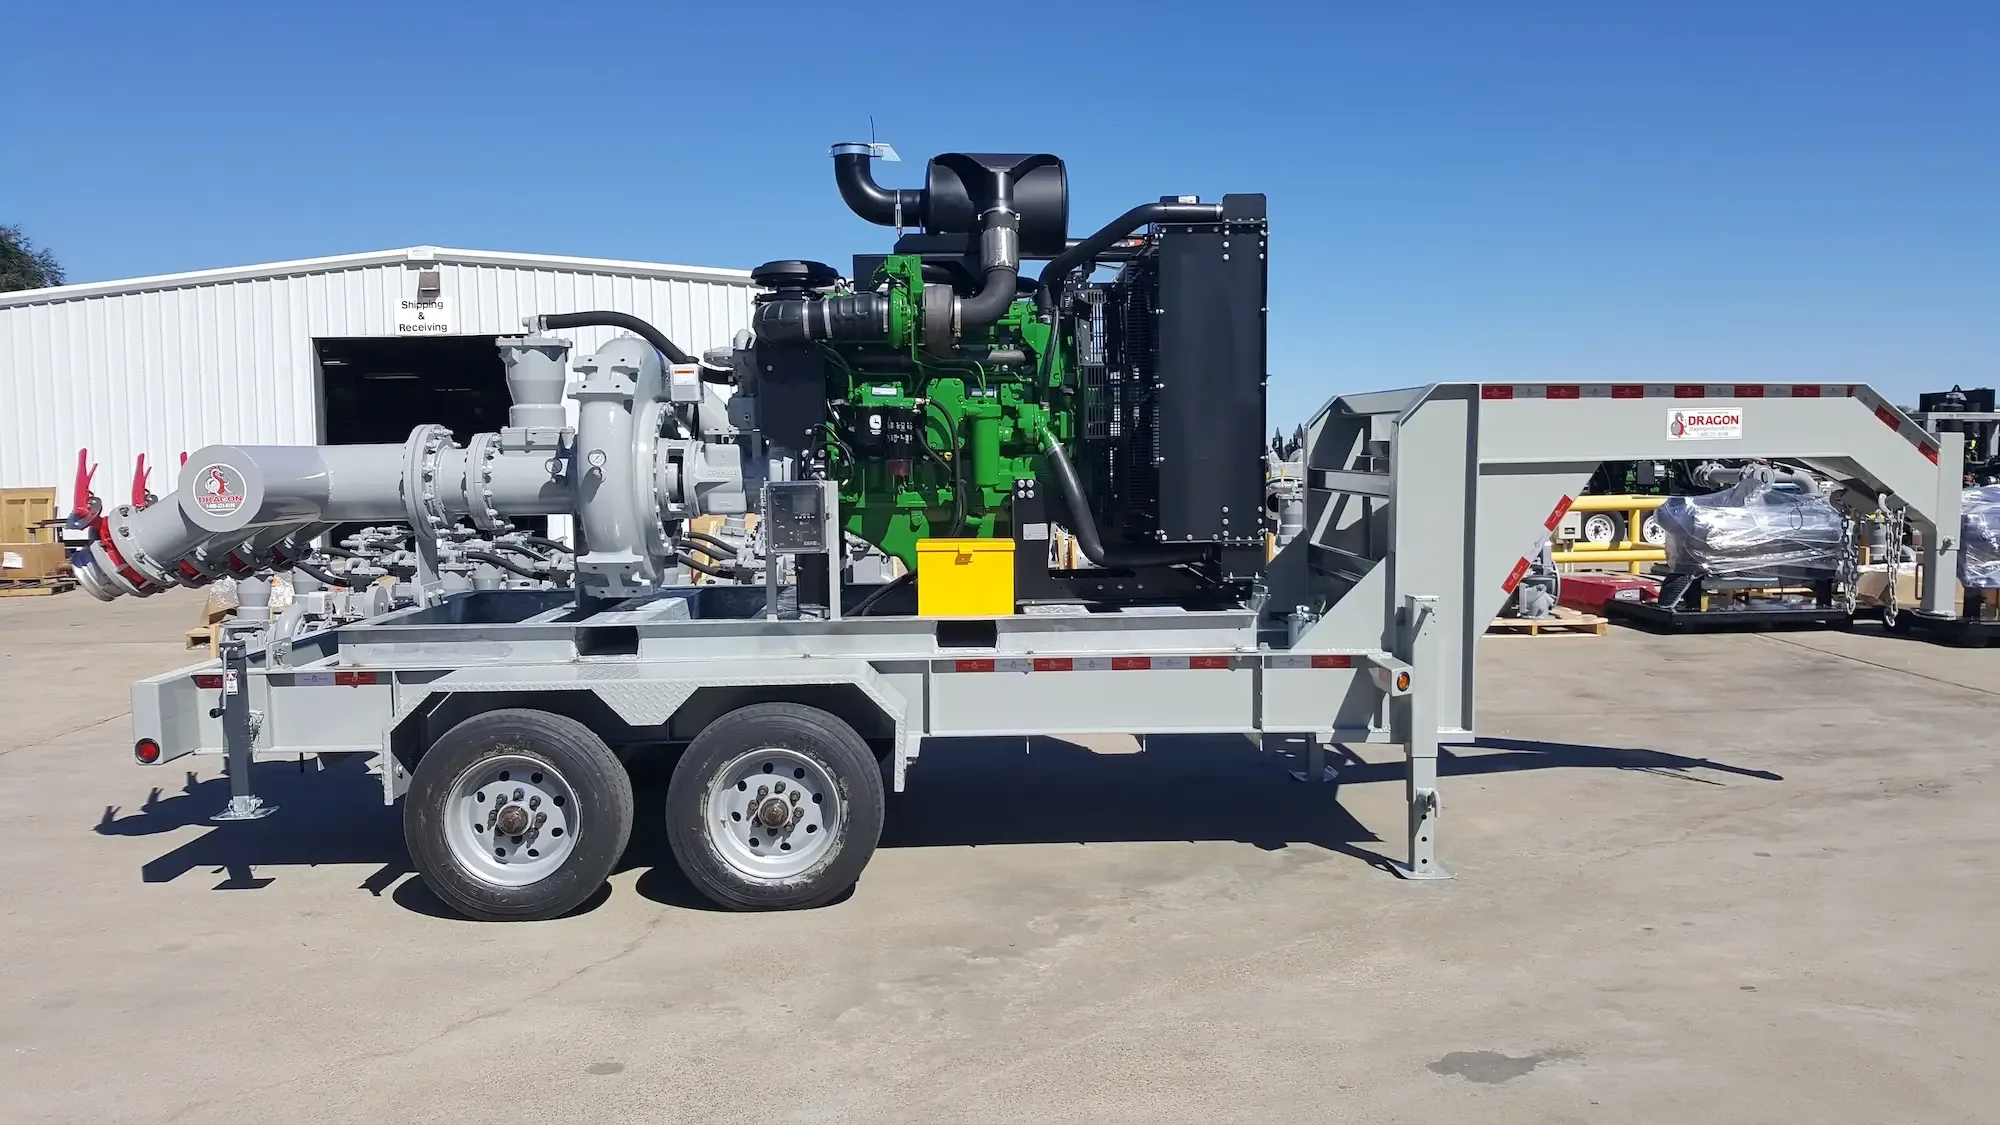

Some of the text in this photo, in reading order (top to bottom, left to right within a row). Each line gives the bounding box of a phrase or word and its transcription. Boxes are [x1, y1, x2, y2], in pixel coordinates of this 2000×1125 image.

[401, 300, 444, 310] Shipping
[417, 311, 425, 320] &
[399, 323, 447, 332] Receiving
[1688, 415, 1739, 426] DRAGON
[198, 495, 243, 503] DRAGON
